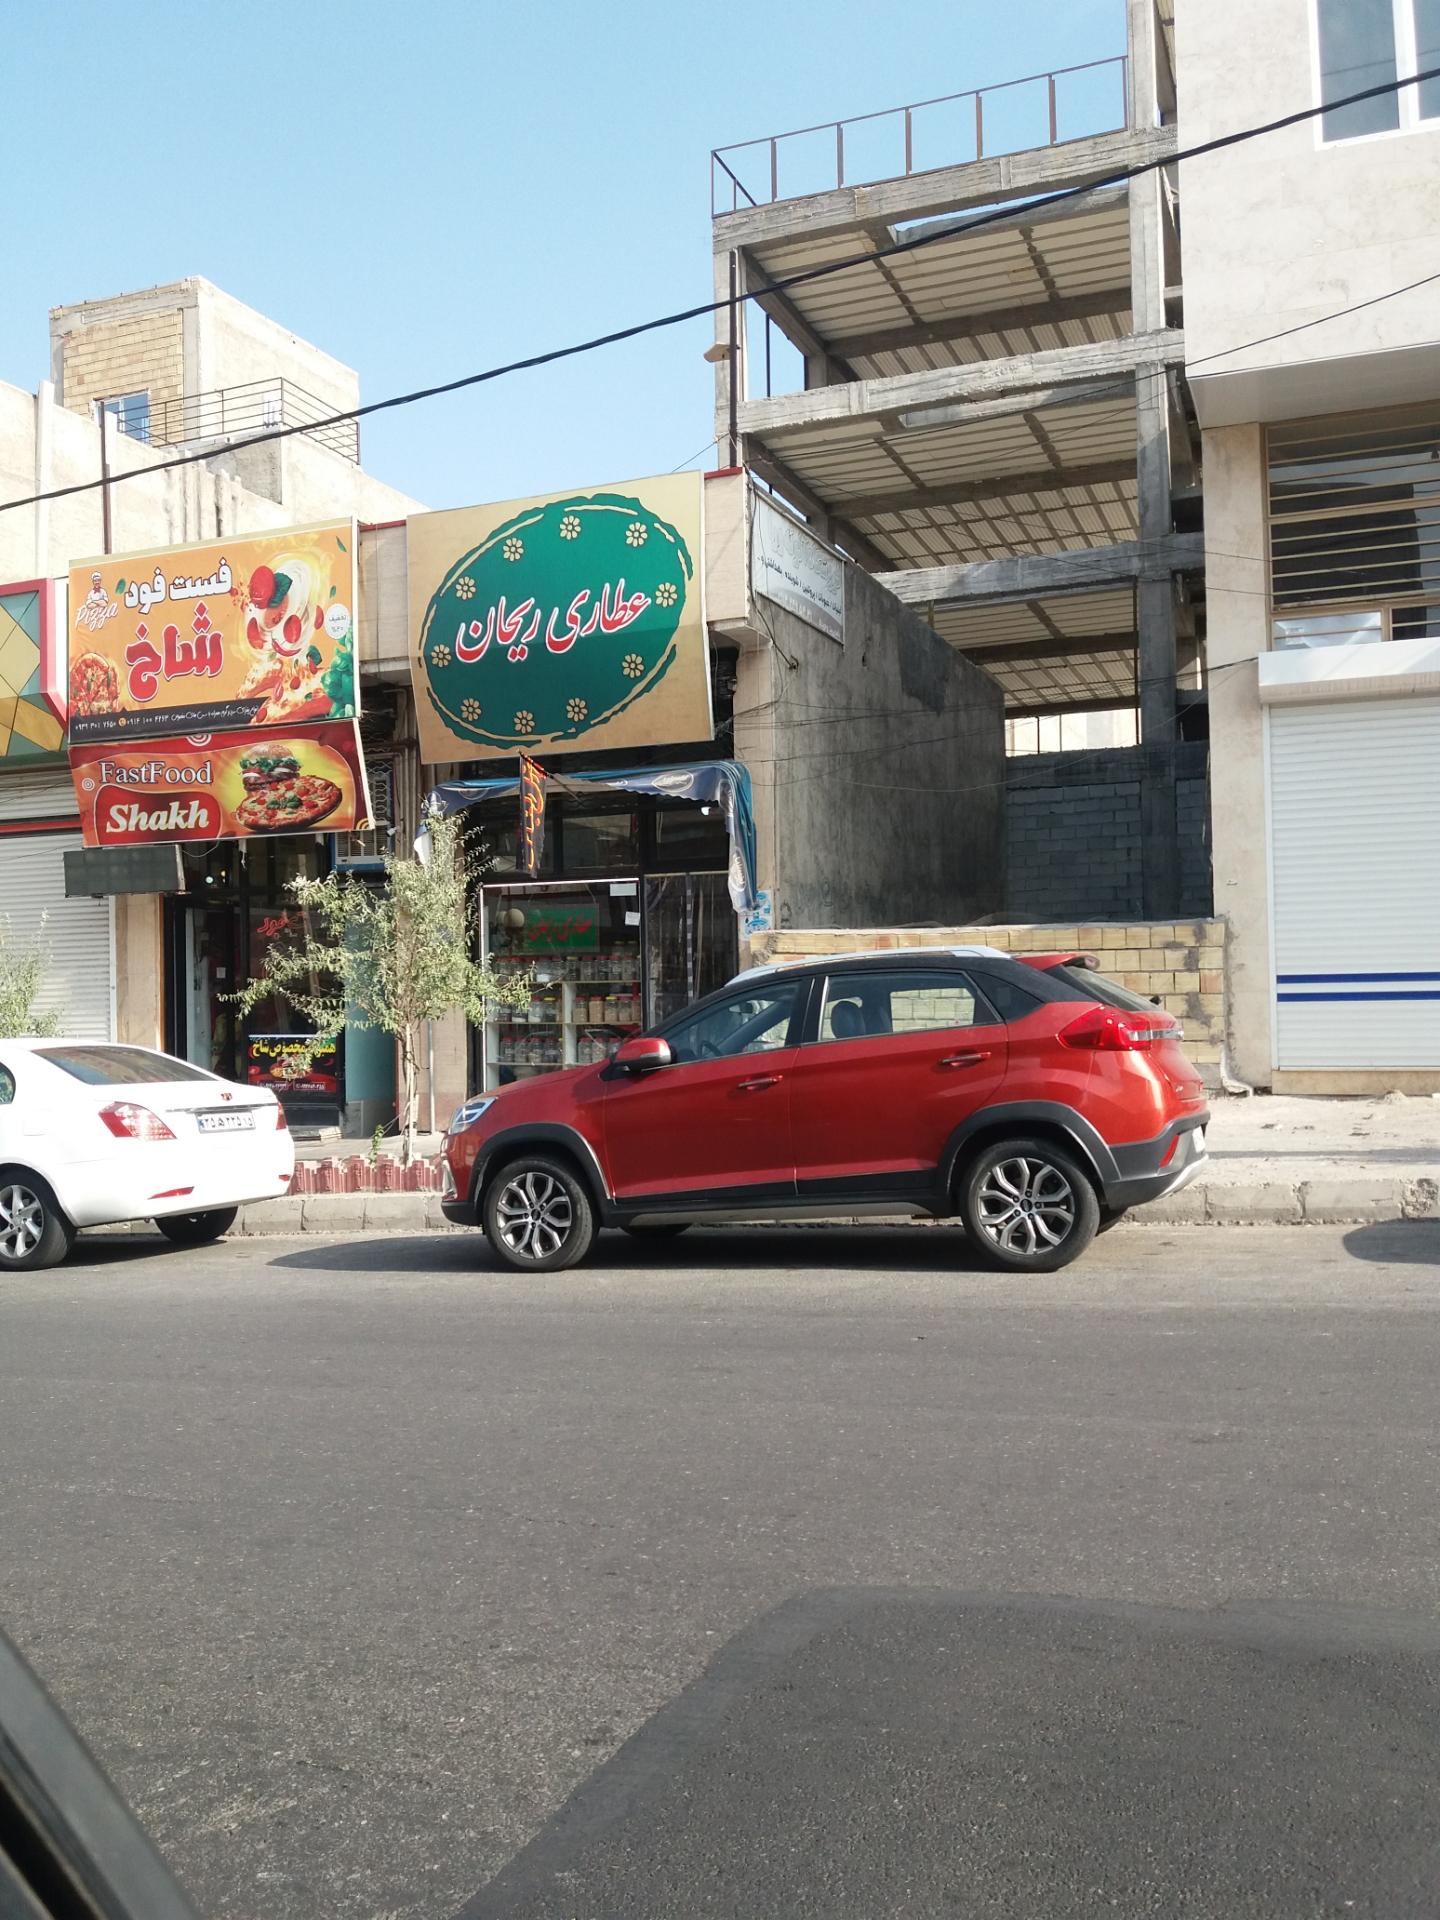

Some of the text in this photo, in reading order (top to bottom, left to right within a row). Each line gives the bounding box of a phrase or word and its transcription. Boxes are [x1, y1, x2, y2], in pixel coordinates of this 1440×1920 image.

[124, 557, 232, 614] فست فود
[75, 602, 119, 631] Pizza
[456, 578, 651, 663] عطاری ریحان
[125, 600, 223, 702] شاخ
[99, 760, 213, 784] FastFood
[106, 800, 209, 832] Shakh
[253, 1040, 269, 1057] شاخ
